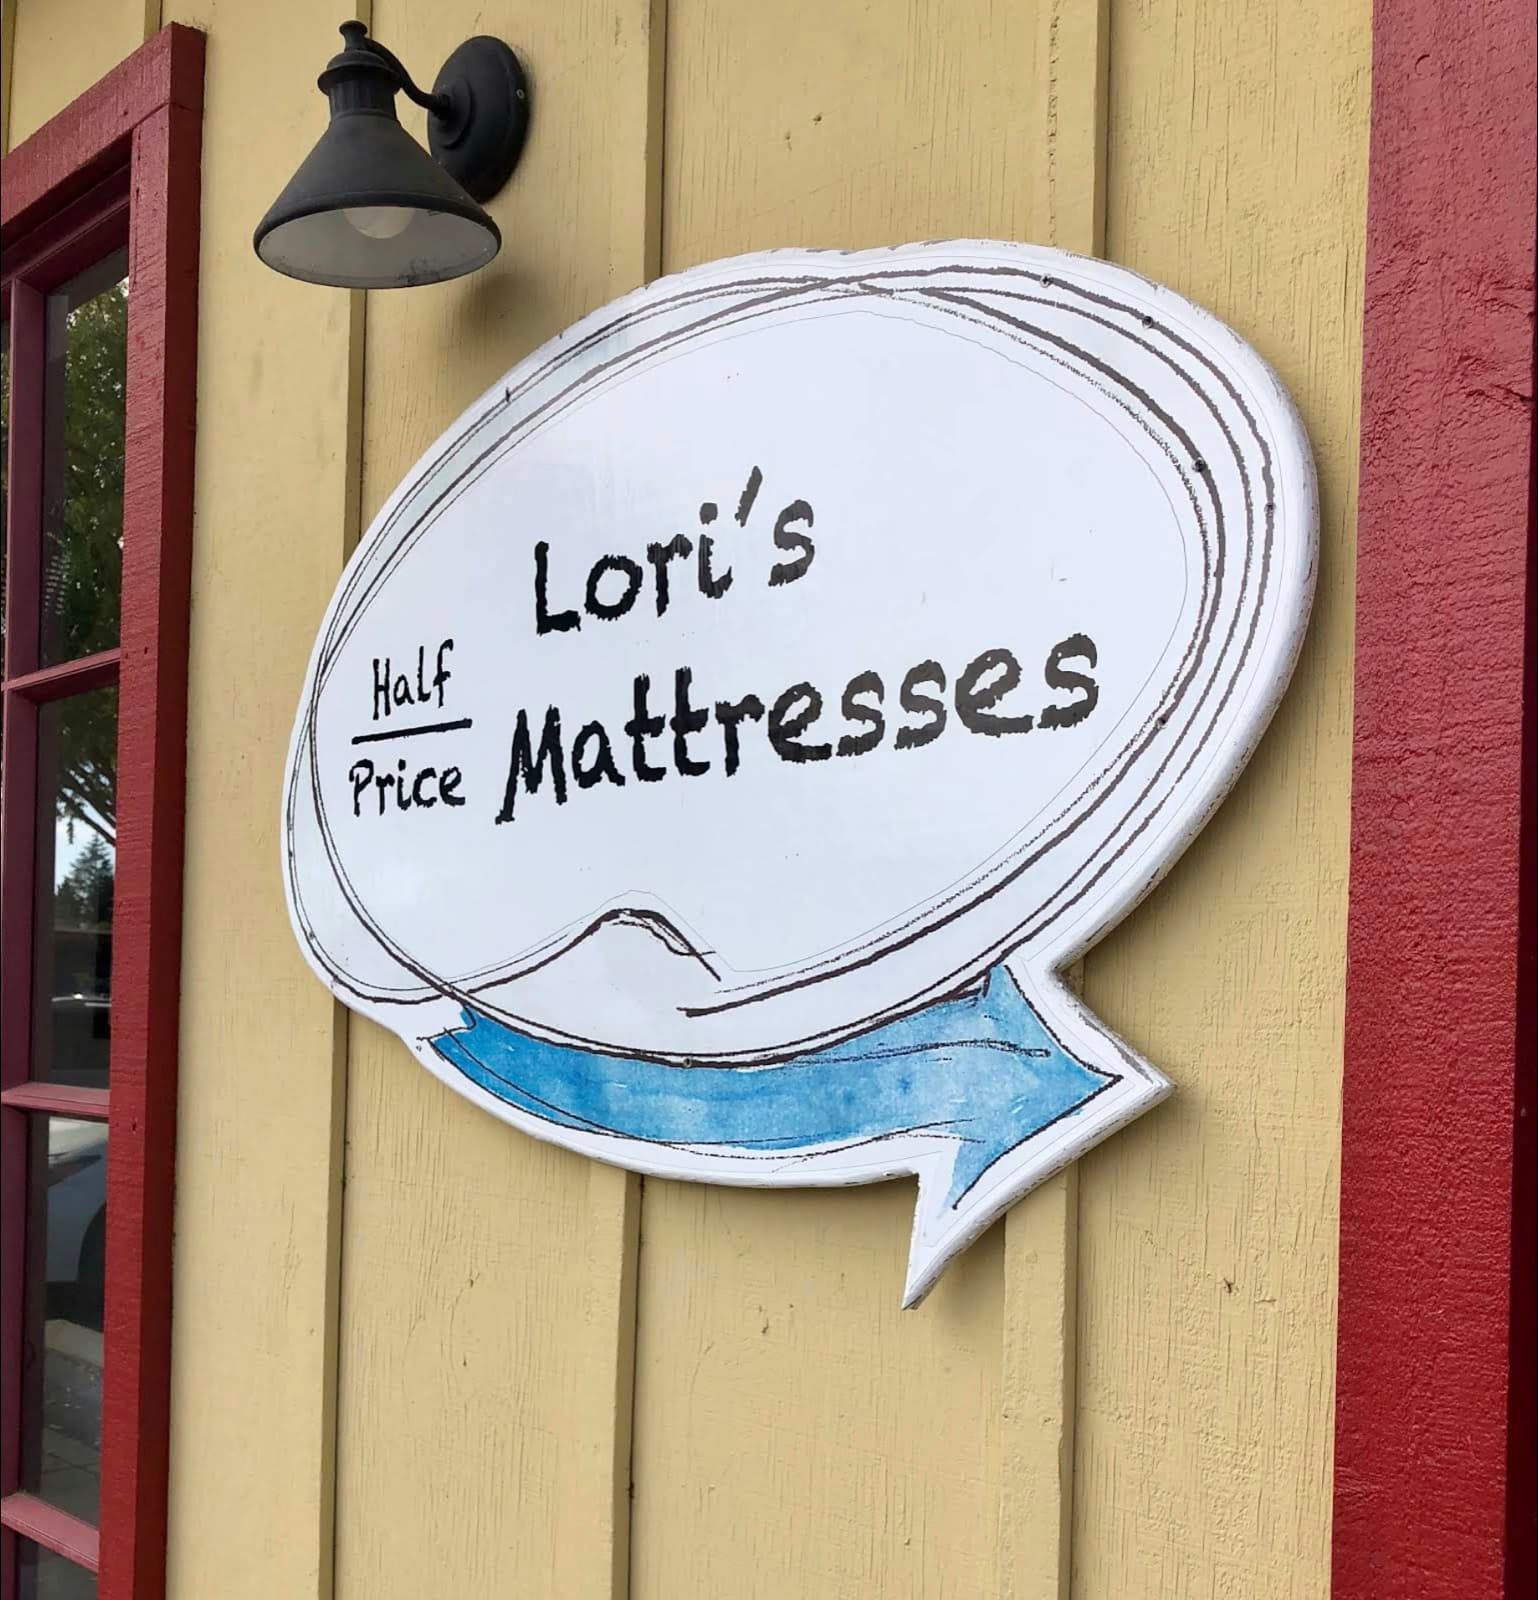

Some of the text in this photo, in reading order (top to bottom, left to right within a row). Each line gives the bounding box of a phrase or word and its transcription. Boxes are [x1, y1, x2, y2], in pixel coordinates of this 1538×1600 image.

[534, 466, 815, 637] Lori's
[372, 638, 454, 721] Half
[494, 632, 1100, 826] Mattresses
[348, 758, 466, 818] Price
